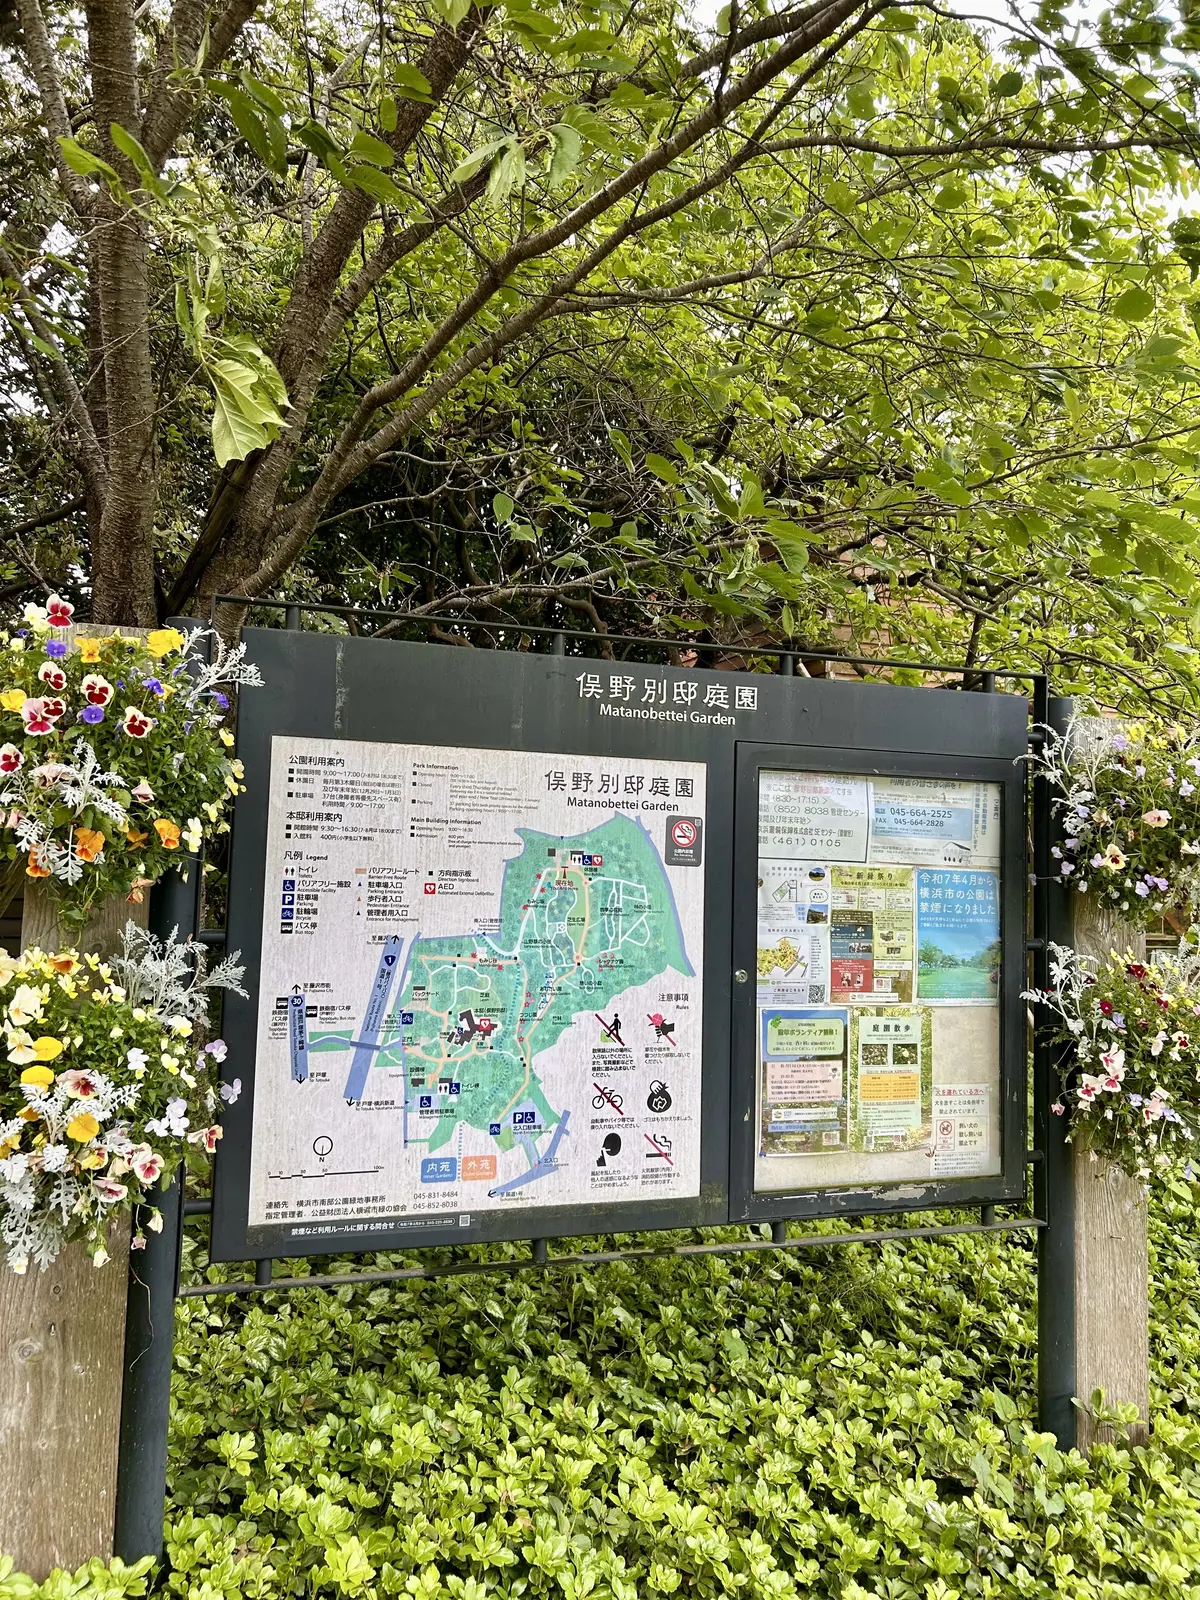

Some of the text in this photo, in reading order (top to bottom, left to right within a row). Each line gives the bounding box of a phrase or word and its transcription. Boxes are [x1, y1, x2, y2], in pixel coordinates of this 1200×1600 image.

[575, 672, 758, 711] 俣野別邸庭園
[599, 703, 736, 726] Matanobettei Garden
[288, 755, 345, 768] 公園利用案内
[412, 762, 459, 772] Park Information
[295, 777, 315, 785] 休園日
[544, 769, 694, 798] 俣野別邸庭園
[566, 796, 680, 813] Matanobettei Garden
[286, 811, 343, 823] 本邸利用案内
[804, 806, 830, 816] 8038
[830, 808, 866, 818] 管理センター
[889, 807, 953, 819] 045-664-2525
[426, 817, 449, 826] Building
[450, 818, 482, 826] Information
[893, 817, 944, 828] 045-664-2828
[415, 825, 433, 833] Opening
[293, 832, 312, 840] 入館料
[810, 838, 842, 848] 0105
[283, 851, 303, 862] 凡例
[306, 854, 328, 862] Legend
[368, 867, 420, 875] バリアフリールート
[438, 870, 472, 878] 方向指示板
[856, 871, 894, 881] 新緑祭り
[297, 880, 352, 889] バリアフリー施設
[367, 881, 403, 889] 駐車場入口
[920, 872, 994, 888] 令和7年4月から
[296, 893, 319, 902] 駐車場
[919, 886, 995, 901] 横浜市の公園は
[367, 895, 402, 903] 歩行者入口
[295, 907, 318, 916] 駐輪場
[366, 909, 408, 917] 管理者用入口
[919, 901, 996, 916] 禁煙になりました
[295, 922, 318, 930] バス停
[293, 997, 302, 1005] 30
[658, 992, 689, 1002] 注意事項
[872, 1024, 911, 1033] 庭園散歩
[513, 1124, 542, 1132] 北入口駐車場
[426, 1162, 451, 1173] 内苑
[467, 1159, 491, 1170] 外苑
[265, 1190, 459, 1210] 連絡先 横浜市南部公園緑地事務所 045-831-8484
[413, 1200, 459, 1210] 045-852-8038
[291, 1222, 396, 1237] 禁煙など利用ルールに関する問合せ
